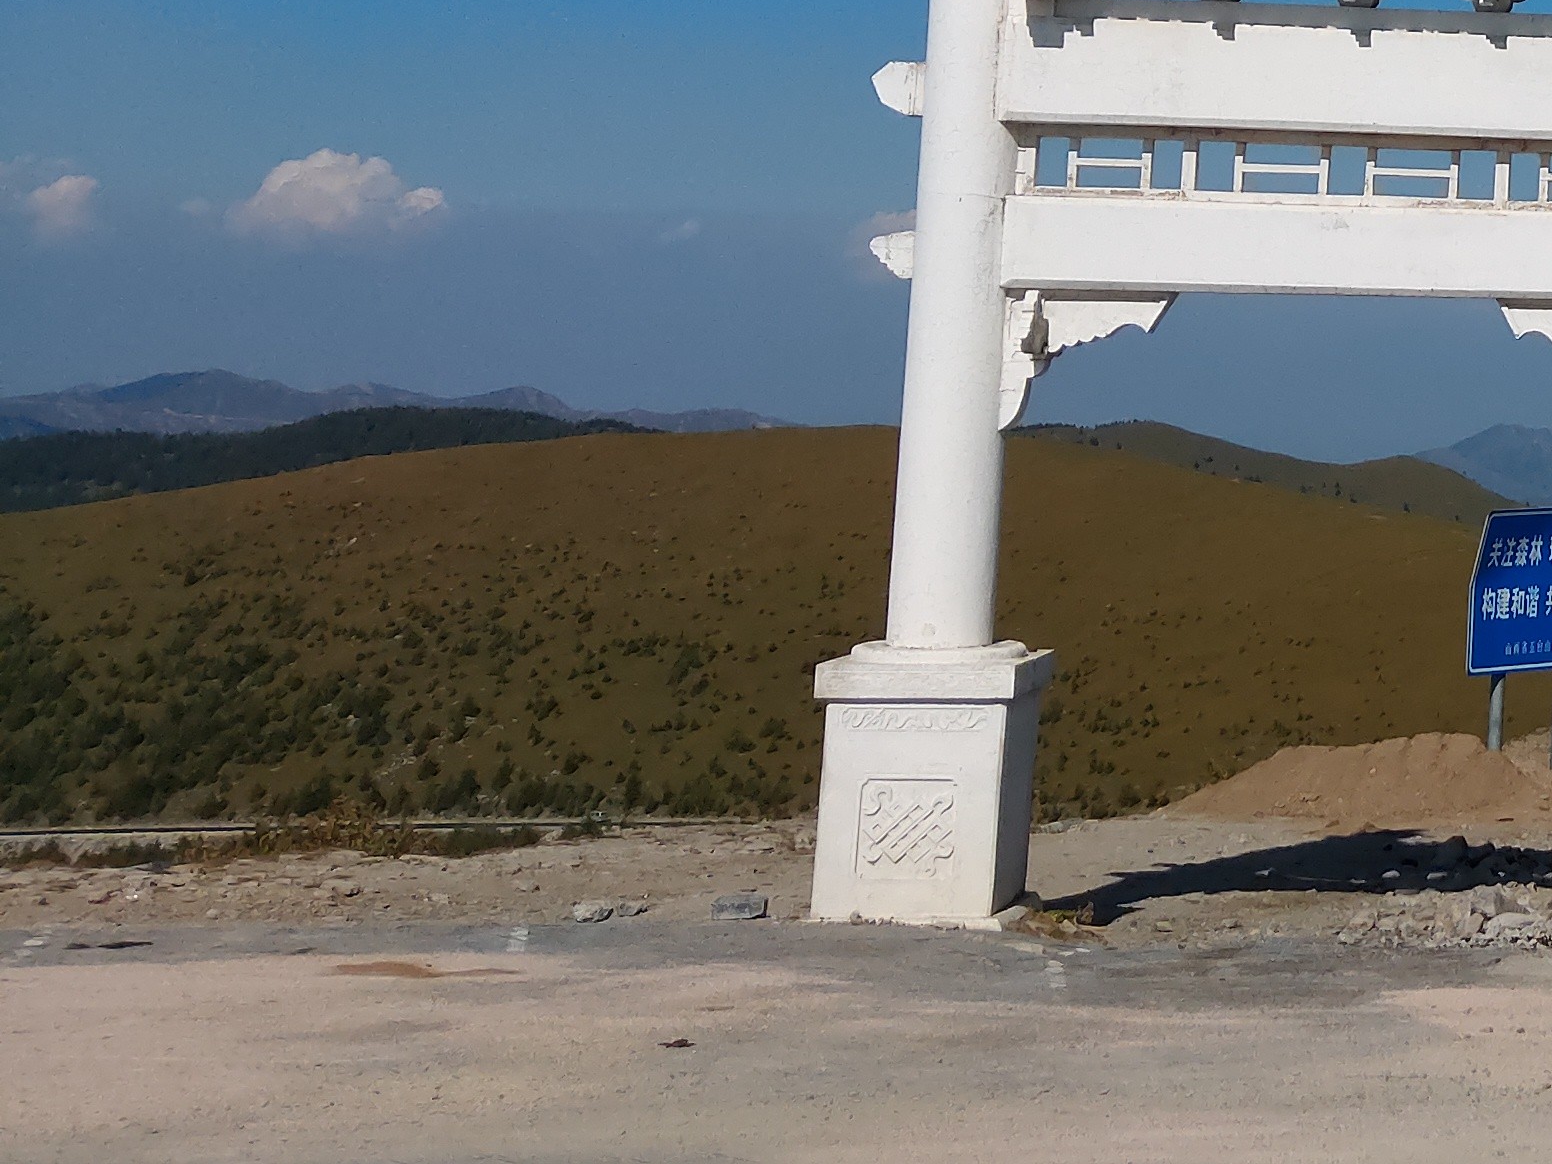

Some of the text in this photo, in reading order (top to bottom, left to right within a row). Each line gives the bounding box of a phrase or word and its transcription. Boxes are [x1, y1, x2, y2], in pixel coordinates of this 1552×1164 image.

[1488, 535, 1543, 567] 关注森林
[1482, 586, 1540, 621] 构建和谐
